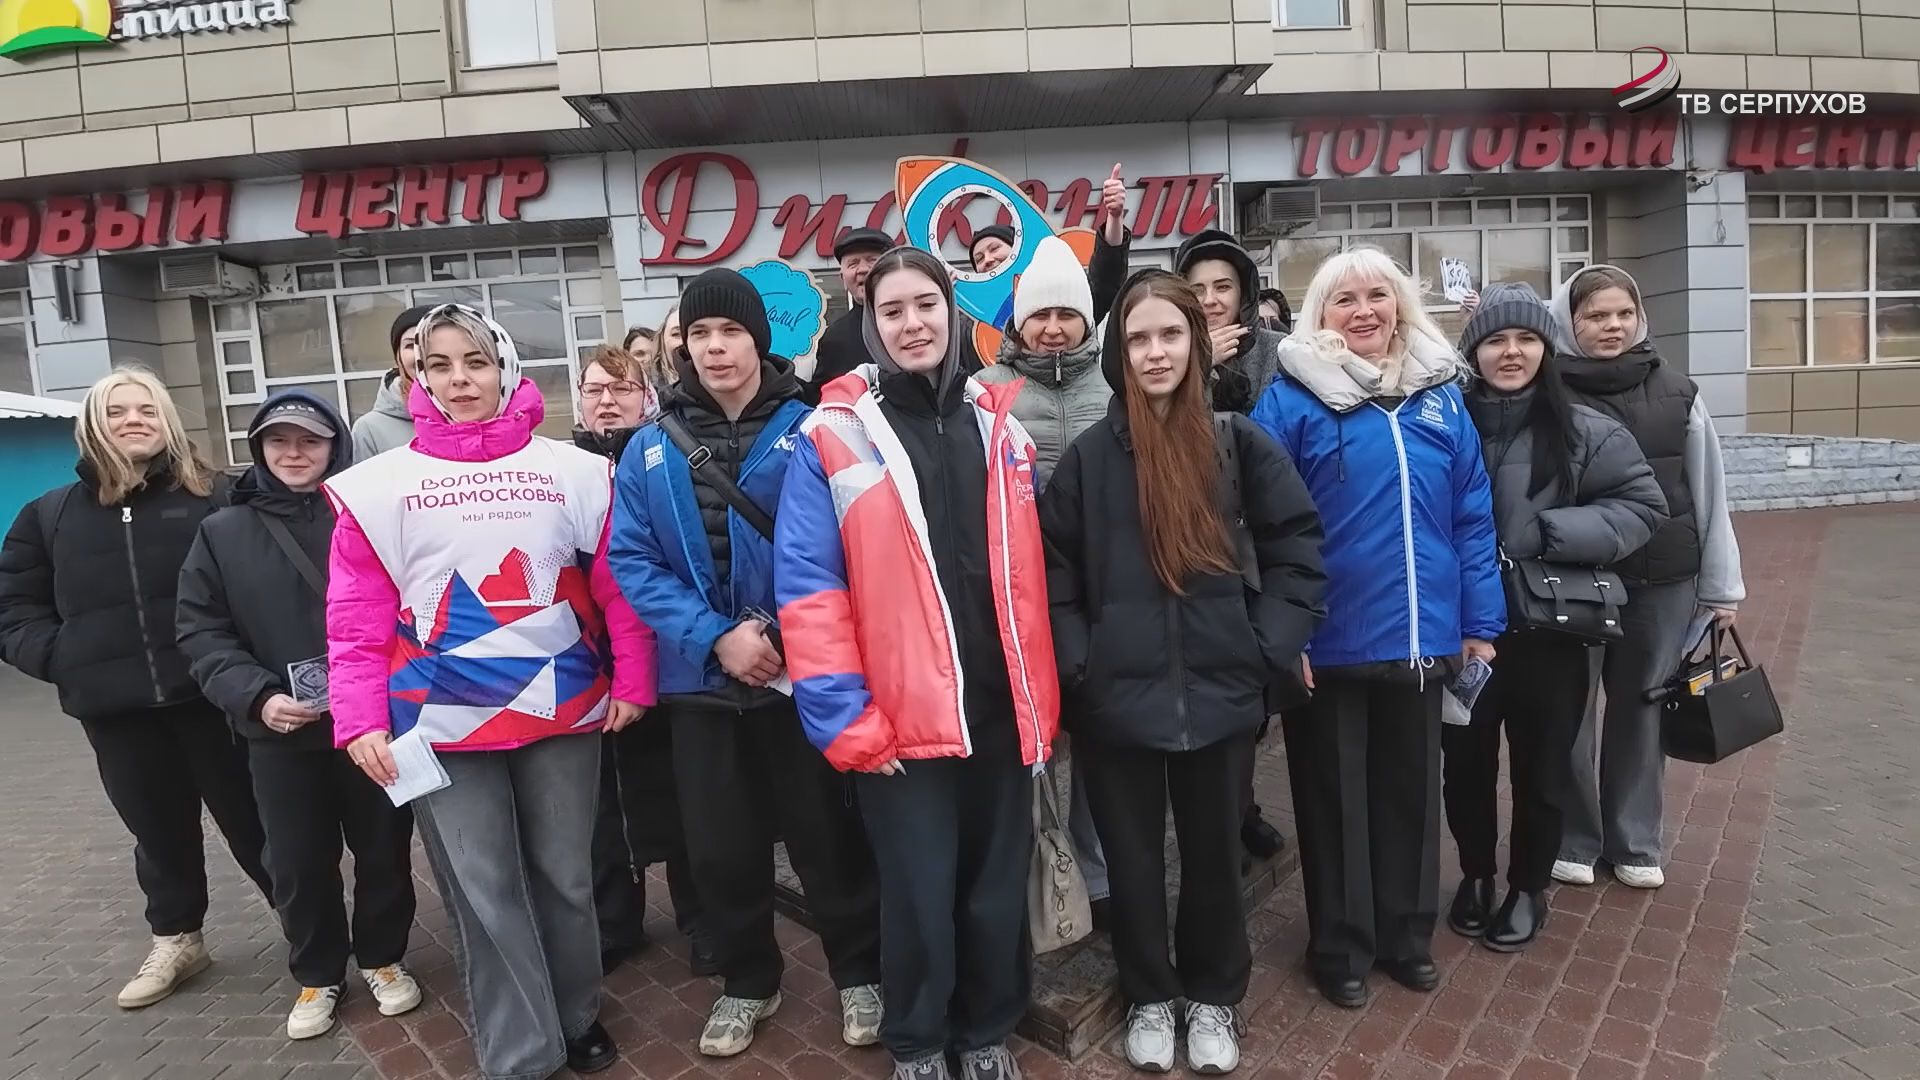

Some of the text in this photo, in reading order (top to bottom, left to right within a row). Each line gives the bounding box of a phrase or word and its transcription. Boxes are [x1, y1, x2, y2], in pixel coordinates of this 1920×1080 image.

[120, 0, 290, 37] пицца
[295, 156, 549, 240] ЦЕНТР
[462, 510, 532, 523] МЫ РЯДОМ
